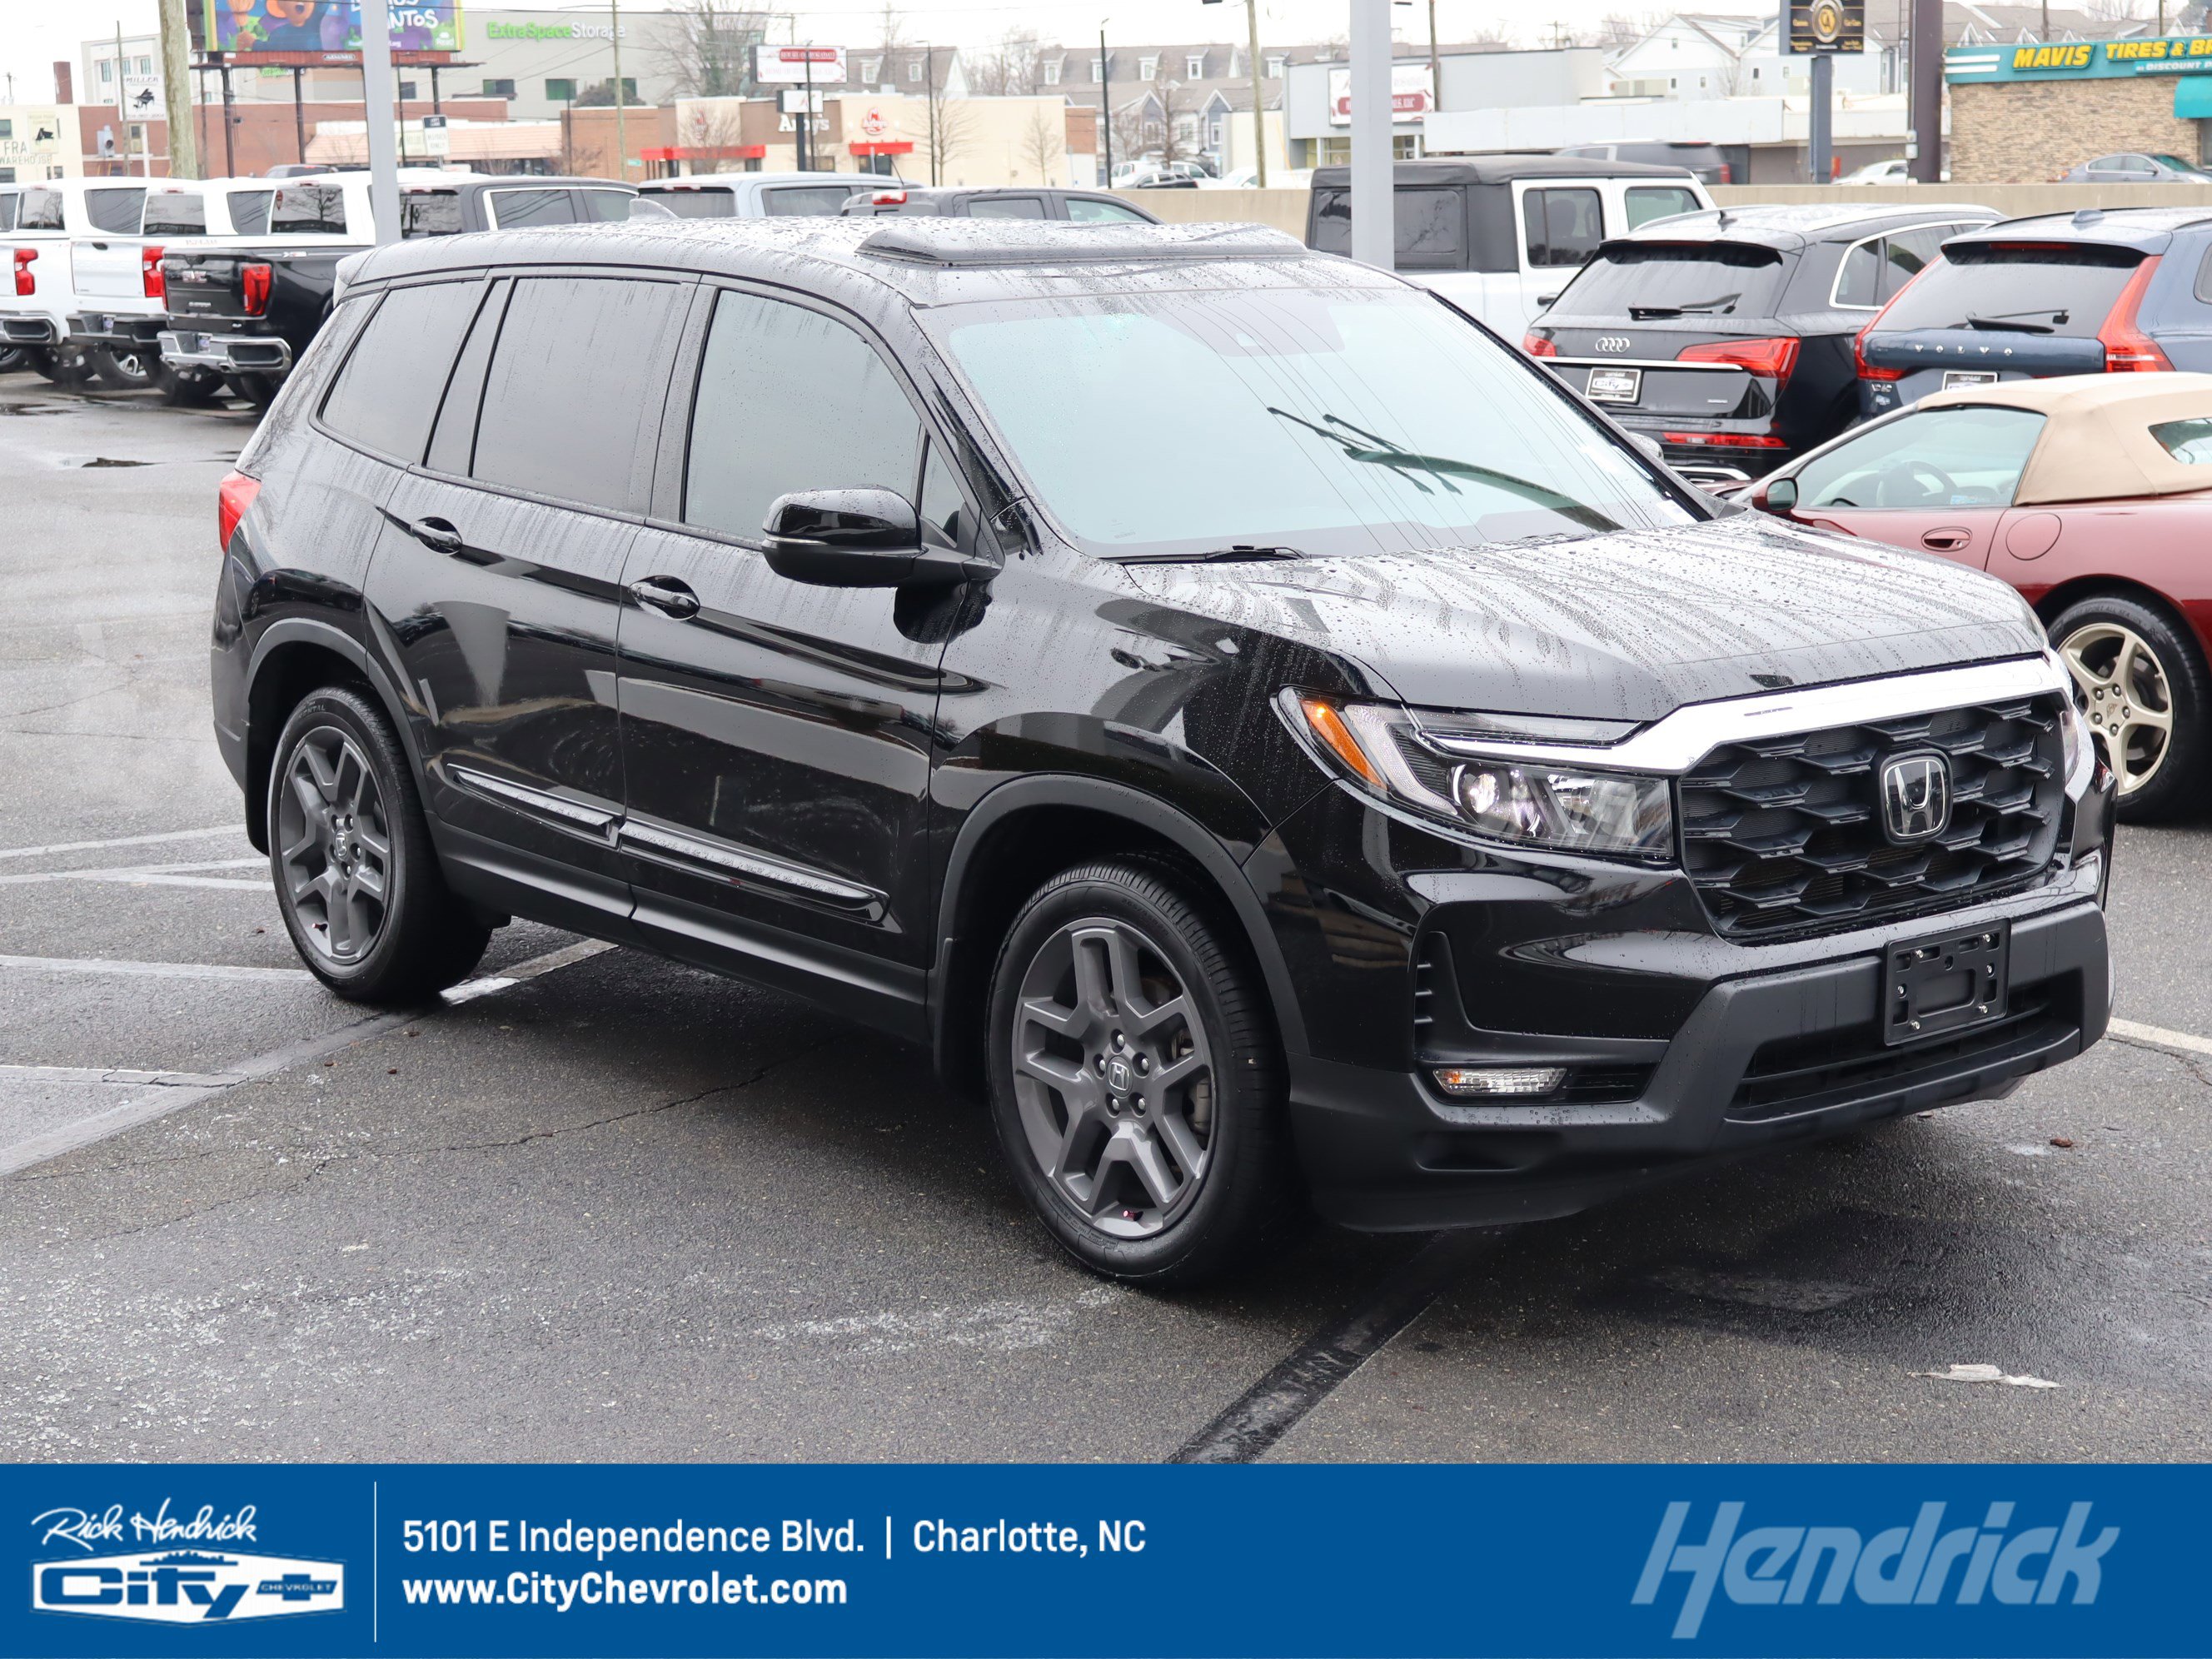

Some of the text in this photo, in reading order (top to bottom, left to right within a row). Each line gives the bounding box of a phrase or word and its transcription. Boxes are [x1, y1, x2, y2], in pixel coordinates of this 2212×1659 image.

[2012, 45, 2092, 68] MAVIS
[2106, 41, 2168, 59] TIRES
[2170, 42, 2185, 57] &
[2145, 61, 2202, 71] DISCOUNT
[1915, 344, 2013, 356] VOLVO
